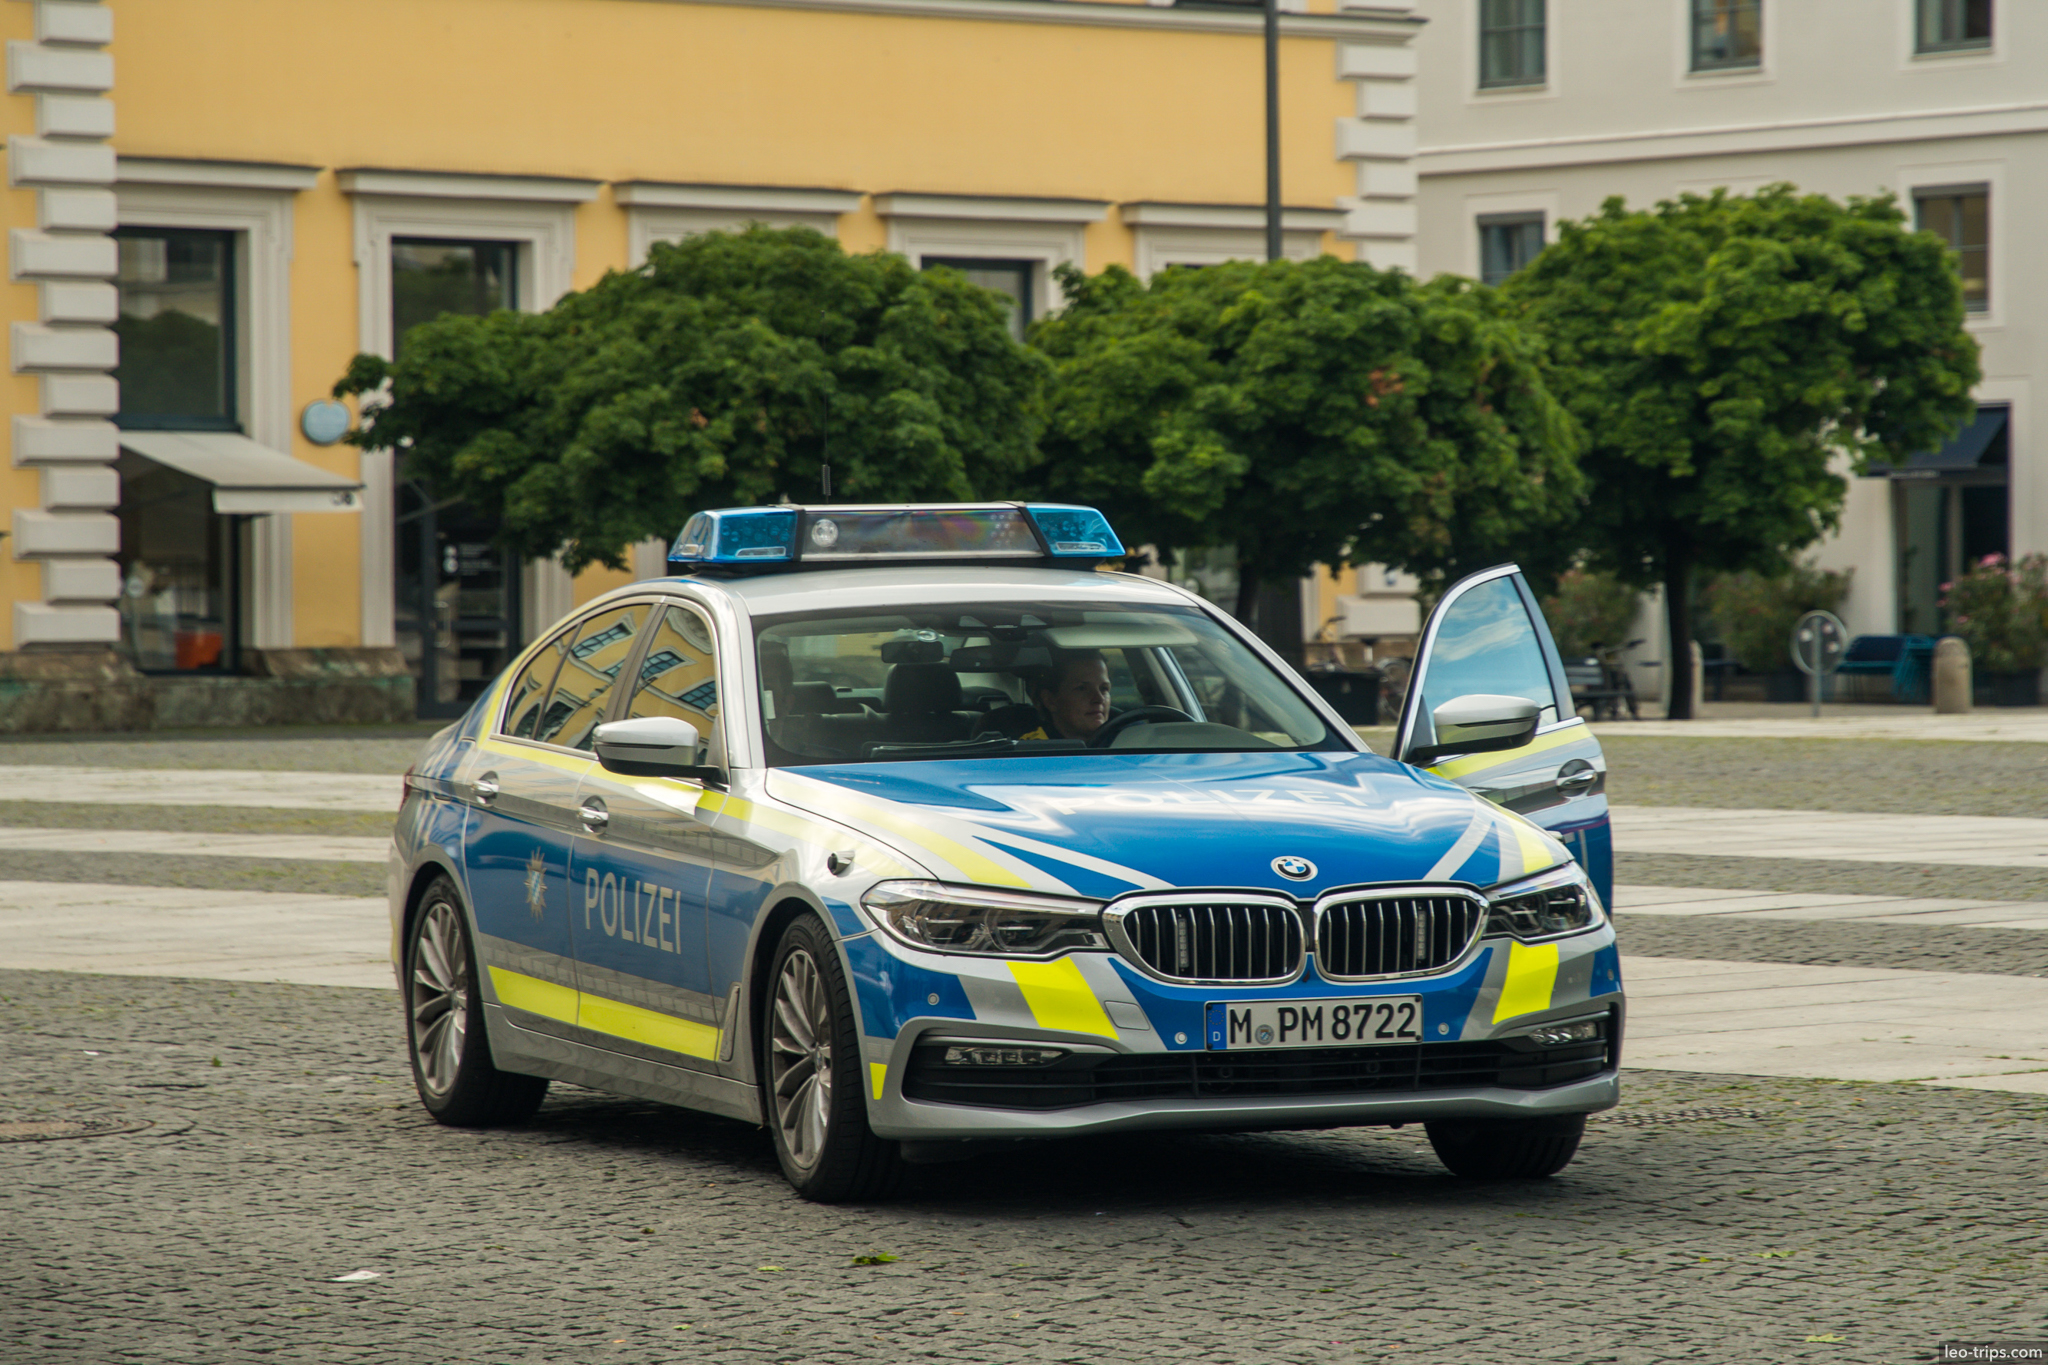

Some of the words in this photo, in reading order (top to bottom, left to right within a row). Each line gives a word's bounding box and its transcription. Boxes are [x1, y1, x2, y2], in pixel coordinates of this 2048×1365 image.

[1044, 789, 1369, 815] POLIZEI
[585, 867, 682, 955] POLIZEI
[1213, 1031, 1221, 1042] D
[1229, 1008, 1252, 1044] M
[1278, 1005, 1323, 1043] PM
[1331, 1002, 1416, 1041] 8722
